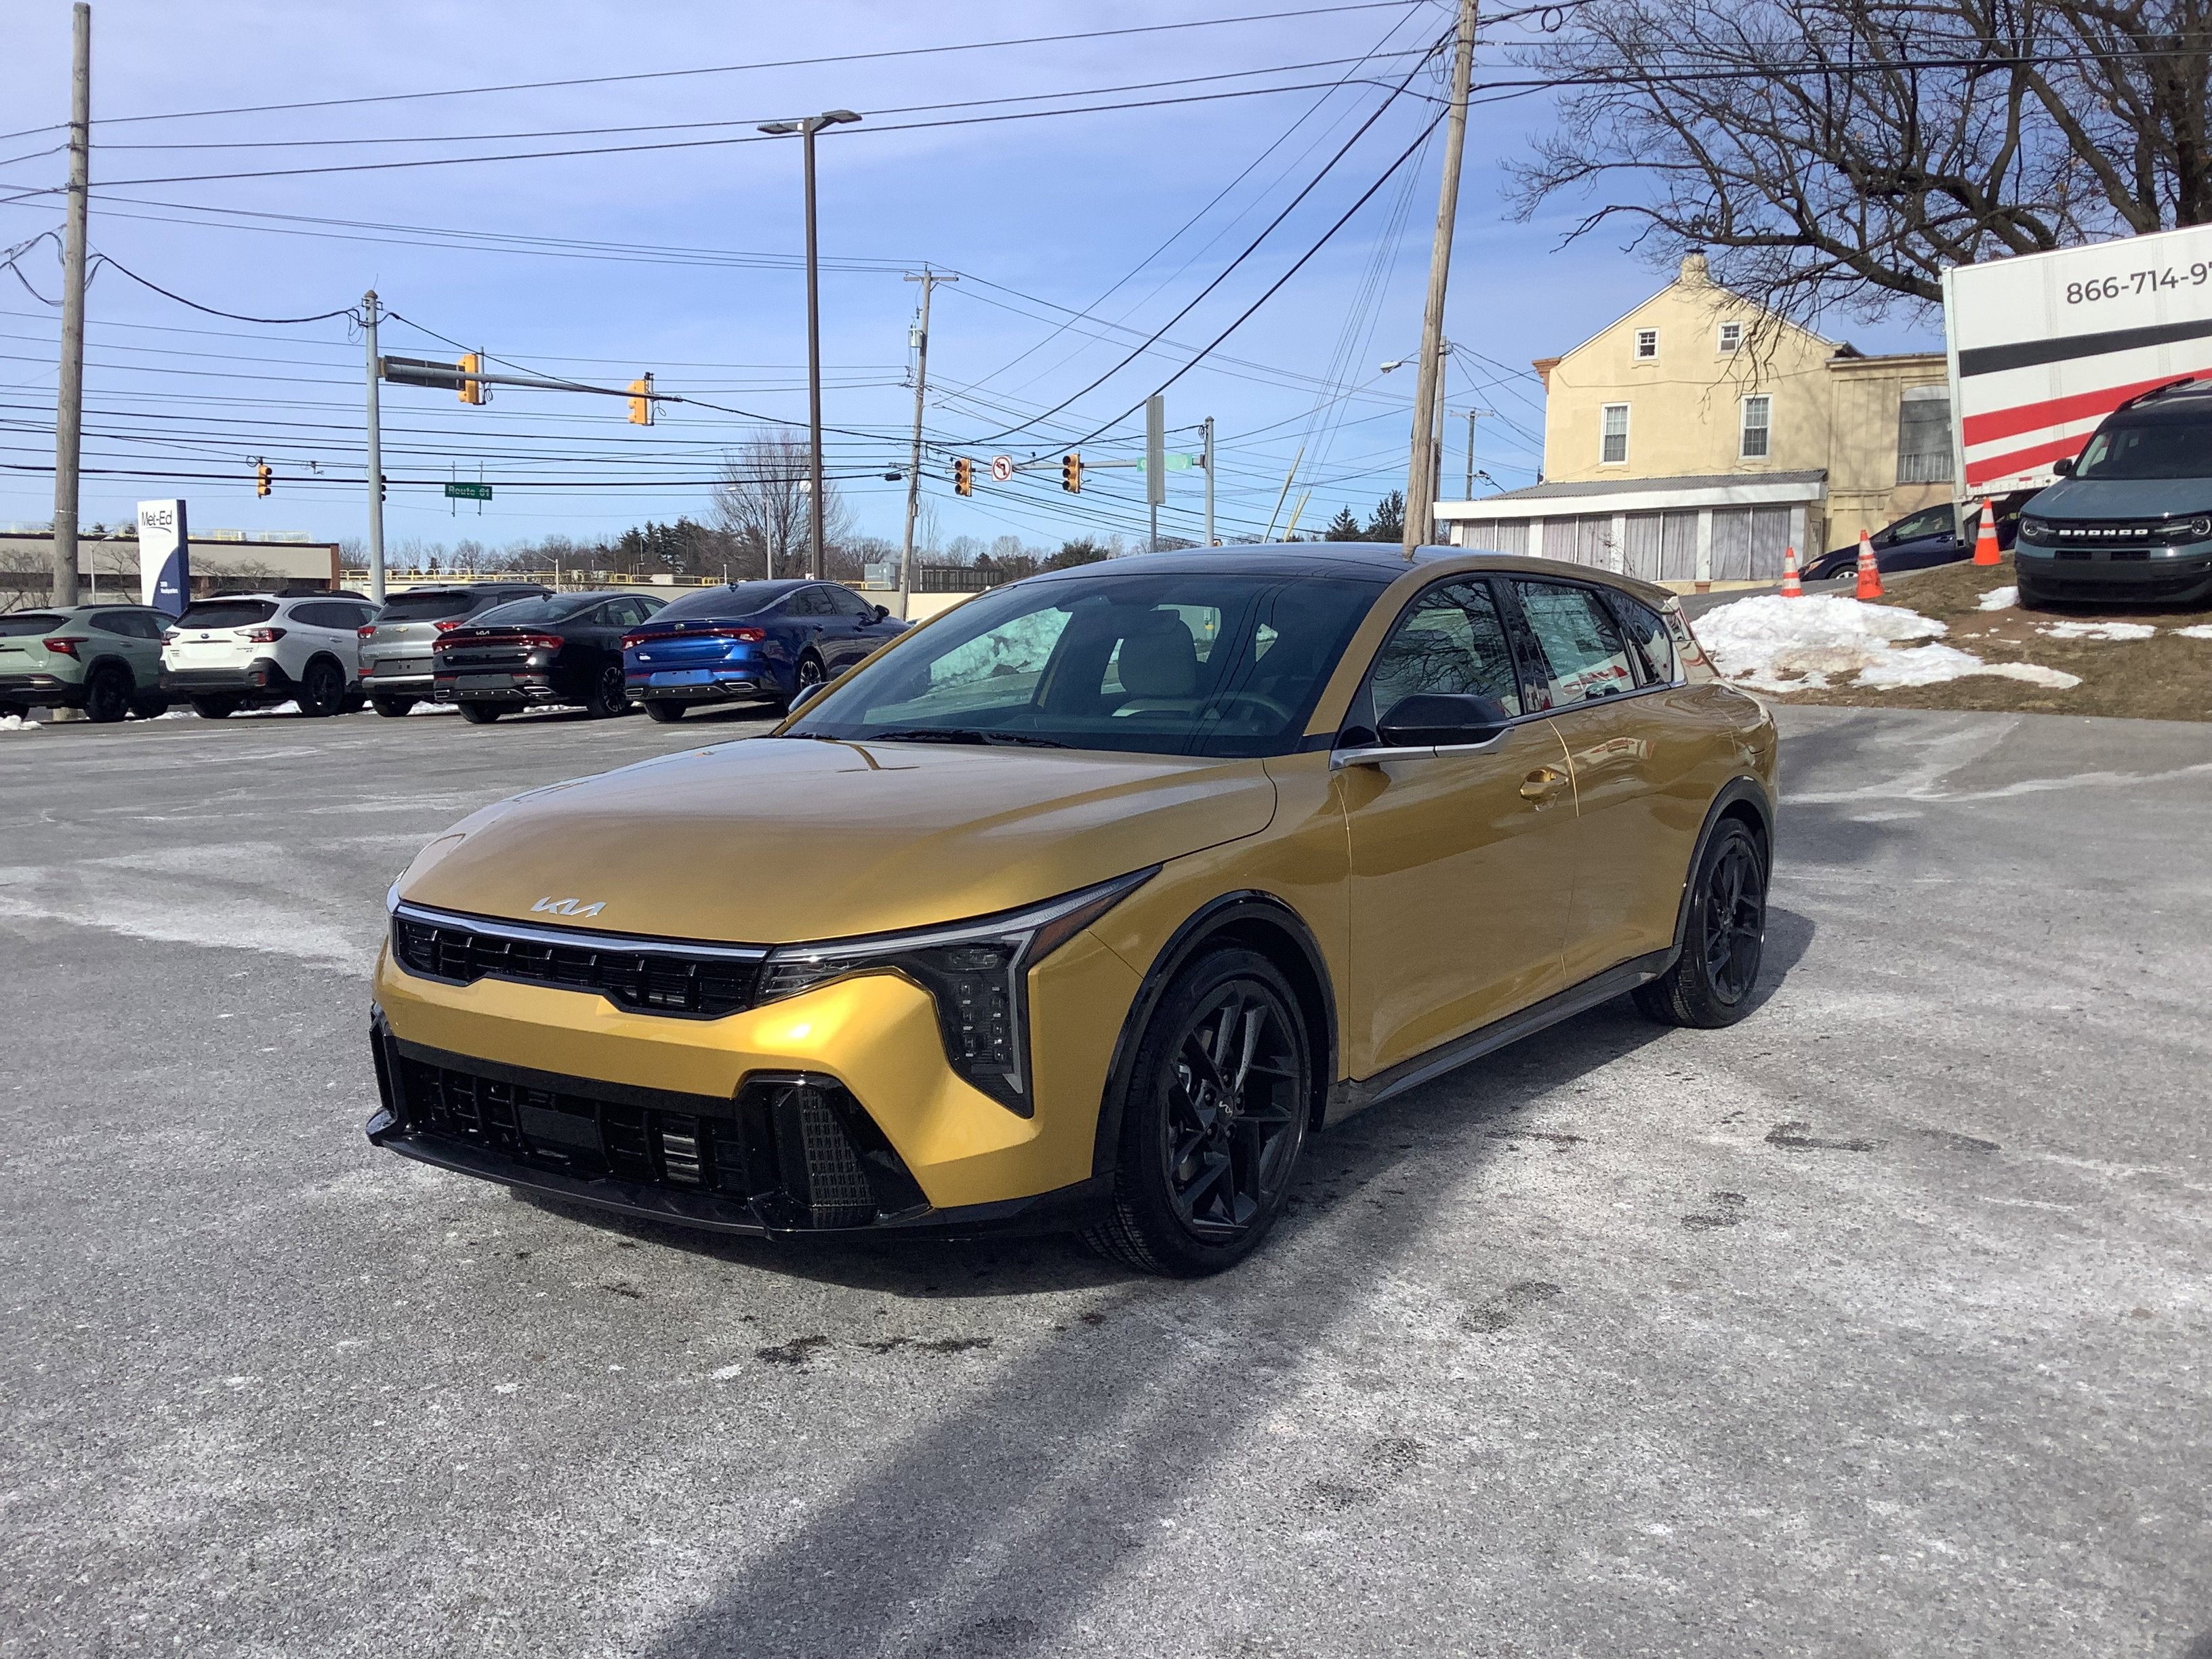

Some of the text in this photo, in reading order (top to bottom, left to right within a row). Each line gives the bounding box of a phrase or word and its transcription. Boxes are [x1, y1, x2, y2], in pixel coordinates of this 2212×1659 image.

[2067, 260, 2212, 304] 866-714-9
[448, 485, 489, 497] Route 61
[141, 510, 172, 526] Met-Ed
[530, 896, 607, 919] KIA
